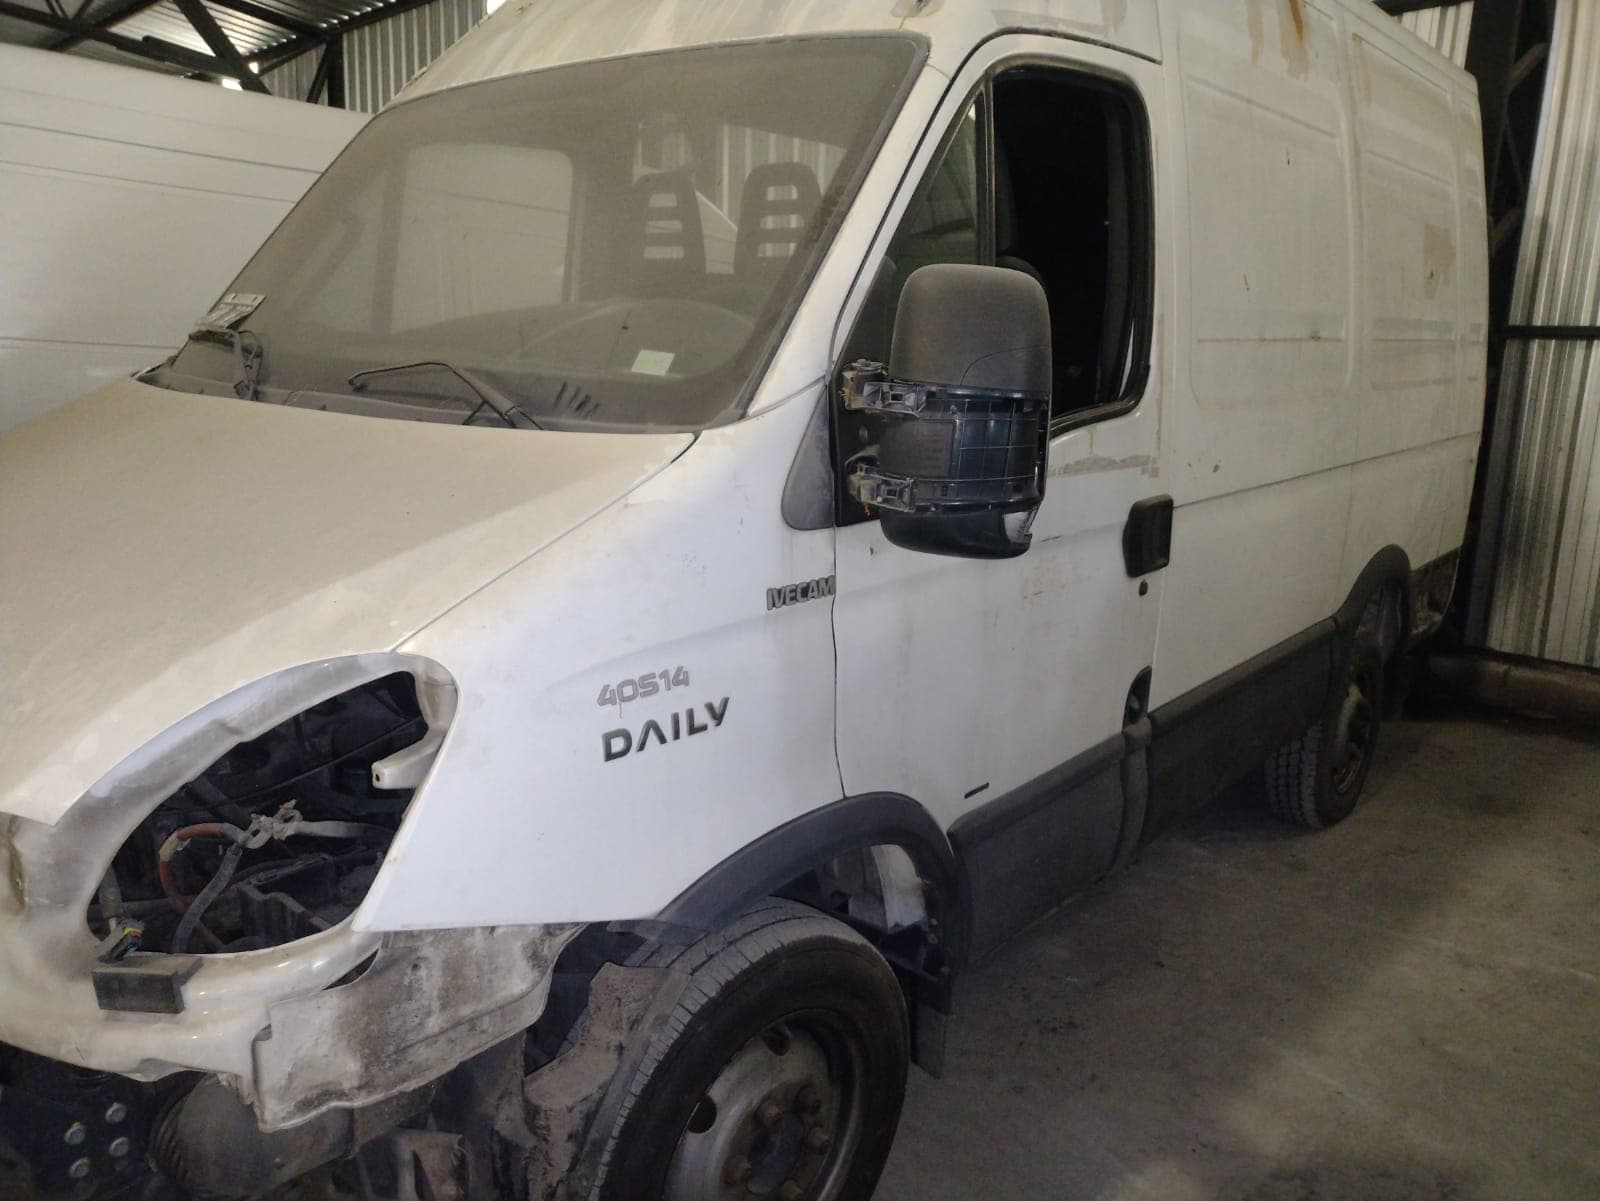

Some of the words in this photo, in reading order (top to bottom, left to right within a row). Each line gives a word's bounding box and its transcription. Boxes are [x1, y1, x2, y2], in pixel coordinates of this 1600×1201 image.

[766, 575, 836, 610] IVECAM
[597, 666, 690, 706] 40S14
[602, 697, 730, 762] DAILY
